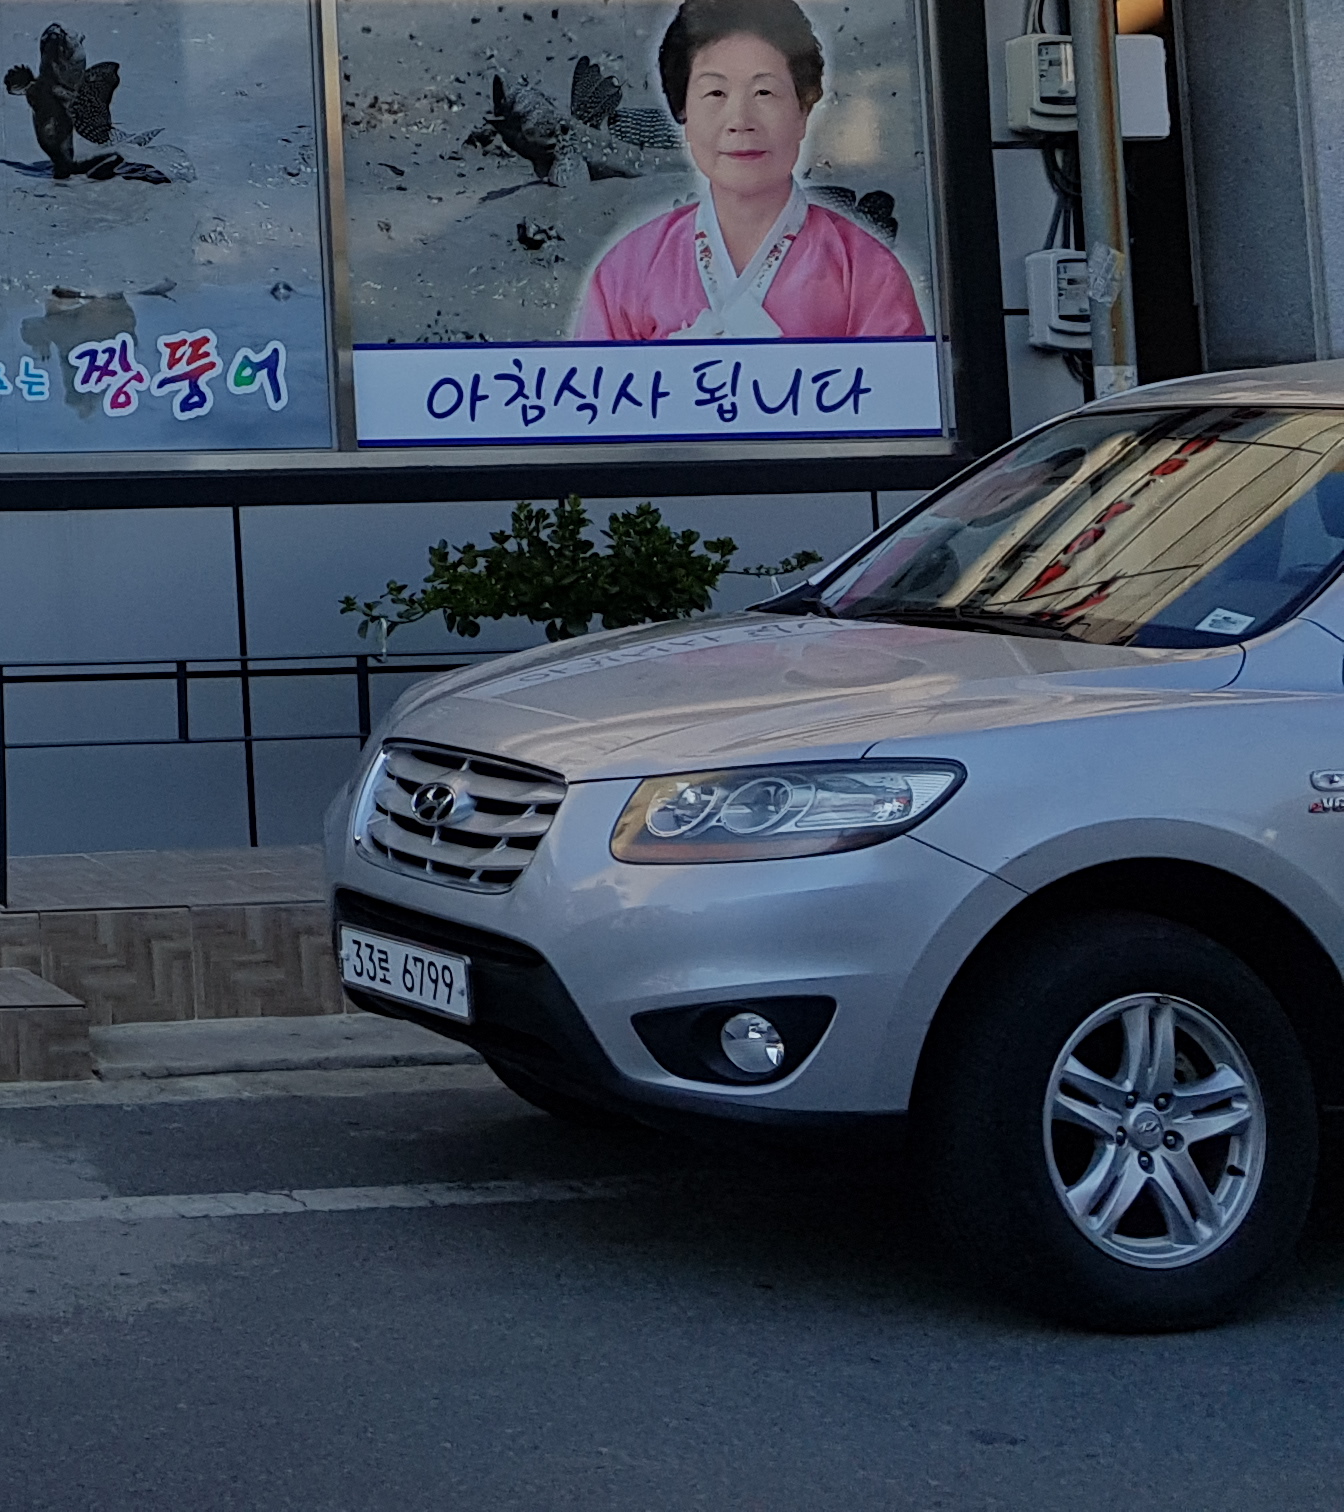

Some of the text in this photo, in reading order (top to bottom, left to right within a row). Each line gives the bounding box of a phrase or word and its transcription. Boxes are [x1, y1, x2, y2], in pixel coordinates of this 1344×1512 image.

[74, 336, 287, 414] 짱뚱어
[426, 357, 873, 426] 아침식사 됩니다
[352, 939, 454, 1005] 33로 6799
